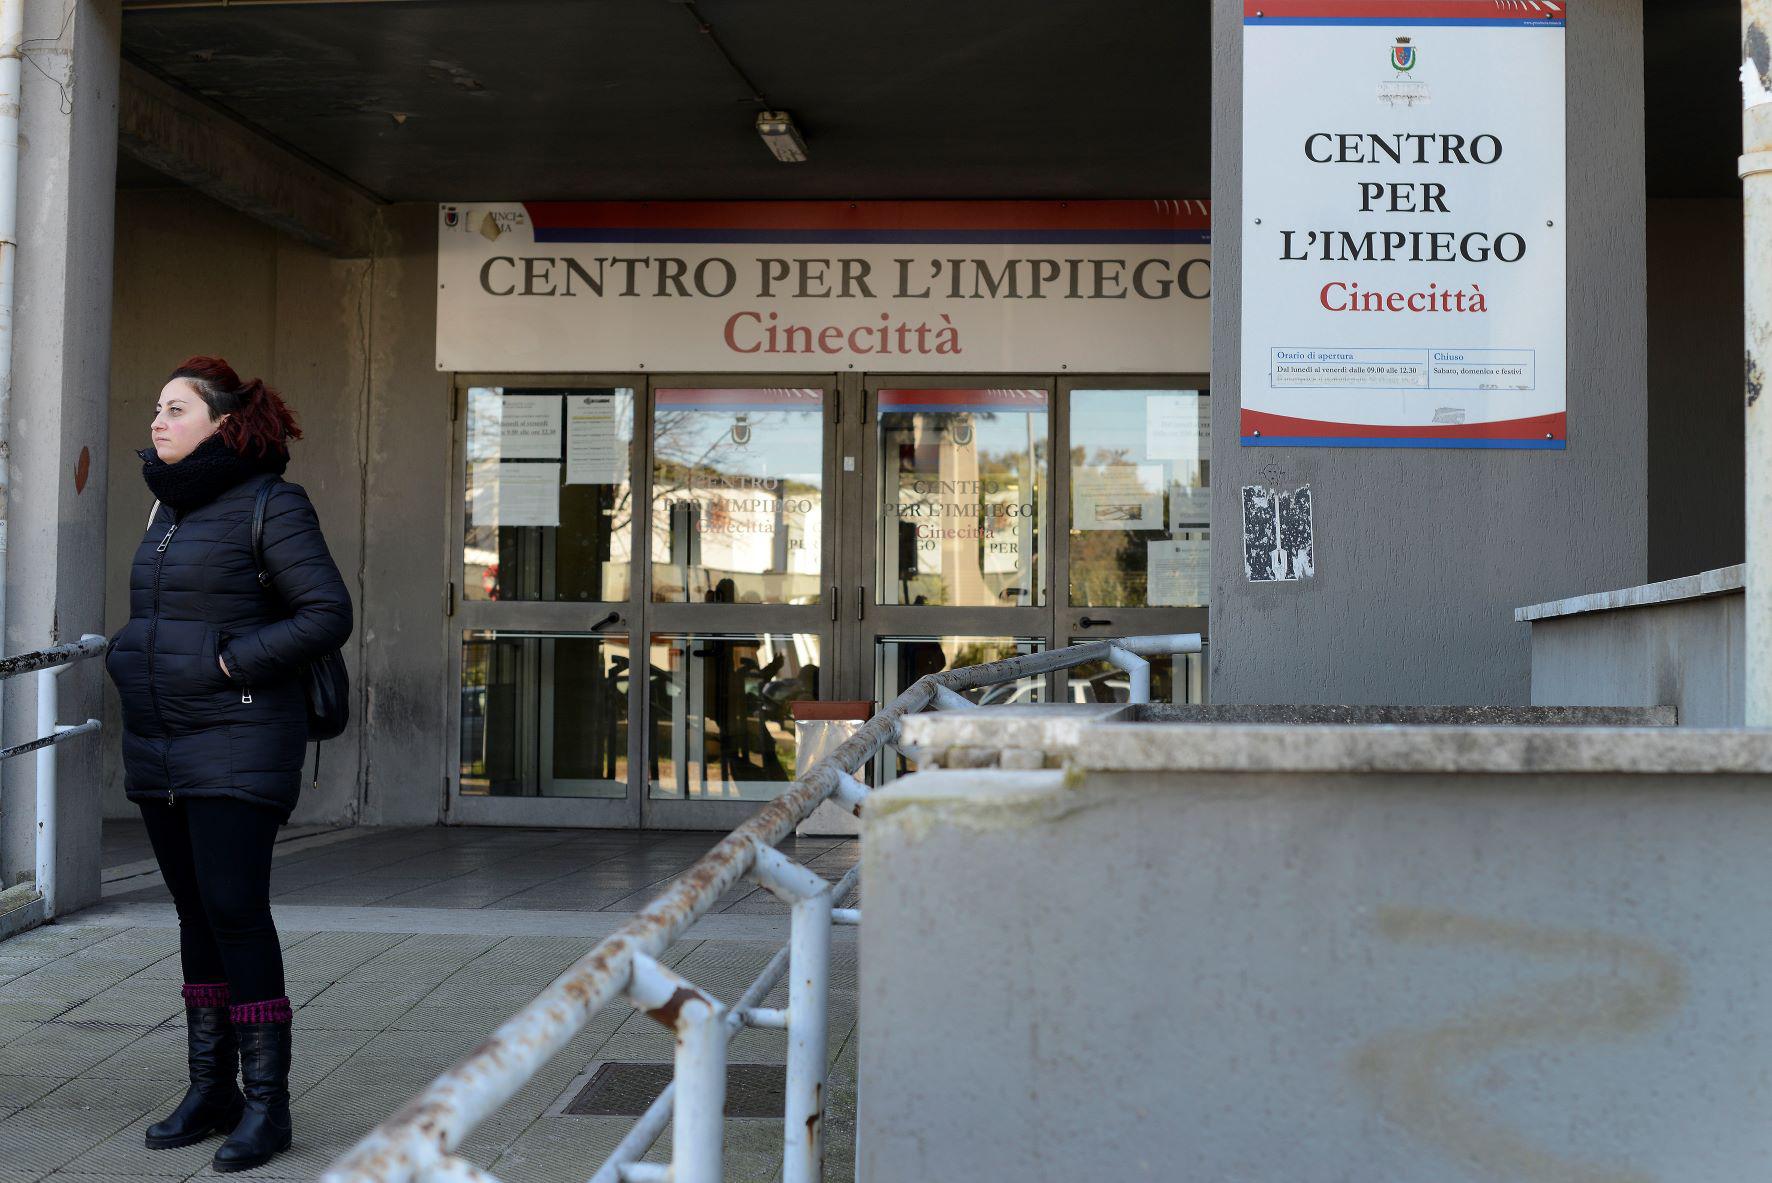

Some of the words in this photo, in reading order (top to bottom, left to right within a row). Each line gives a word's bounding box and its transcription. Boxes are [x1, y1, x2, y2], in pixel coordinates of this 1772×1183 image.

[1305, 133, 1502, 164] CENTRO
[1358, 183, 1450, 213] PER
[1280, 231, 1526, 262] L'IMPIEGO
[480, 256, 737, 298] CENTRO
[755, 258, 877, 298] PER
[893, 258, 1210, 300] L'IMPIEGO
[1320, 281, 1488, 313] Cinecittà
[724, 311, 962, 355] Cinecittà
[1277, 351, 1305, 360] Orario
[1307, 352, 1316, 360] di
[1318, 352, 1354, 361] apertura
[1434, 353, 1464, 361] Chiuso
[1349, 366, 1365, 374] dalle
[1433, 367, 1459, 375] Sabato,
[1460, 367, 1494, 375] domenica
[1501, 367, 1522, 375] festivi
[697, 476, 779, 490] CENTRO
[913, 480, 999, 494] CENTRO
[663, 499, 701, 512] PER
[884, 503, 922, 517] PER
[928, 503, 1033, 518] L'IMPIEGO
[696, 519, 775, 533] Cinecittà
[916, 524, 995, 539] Cinecittà
